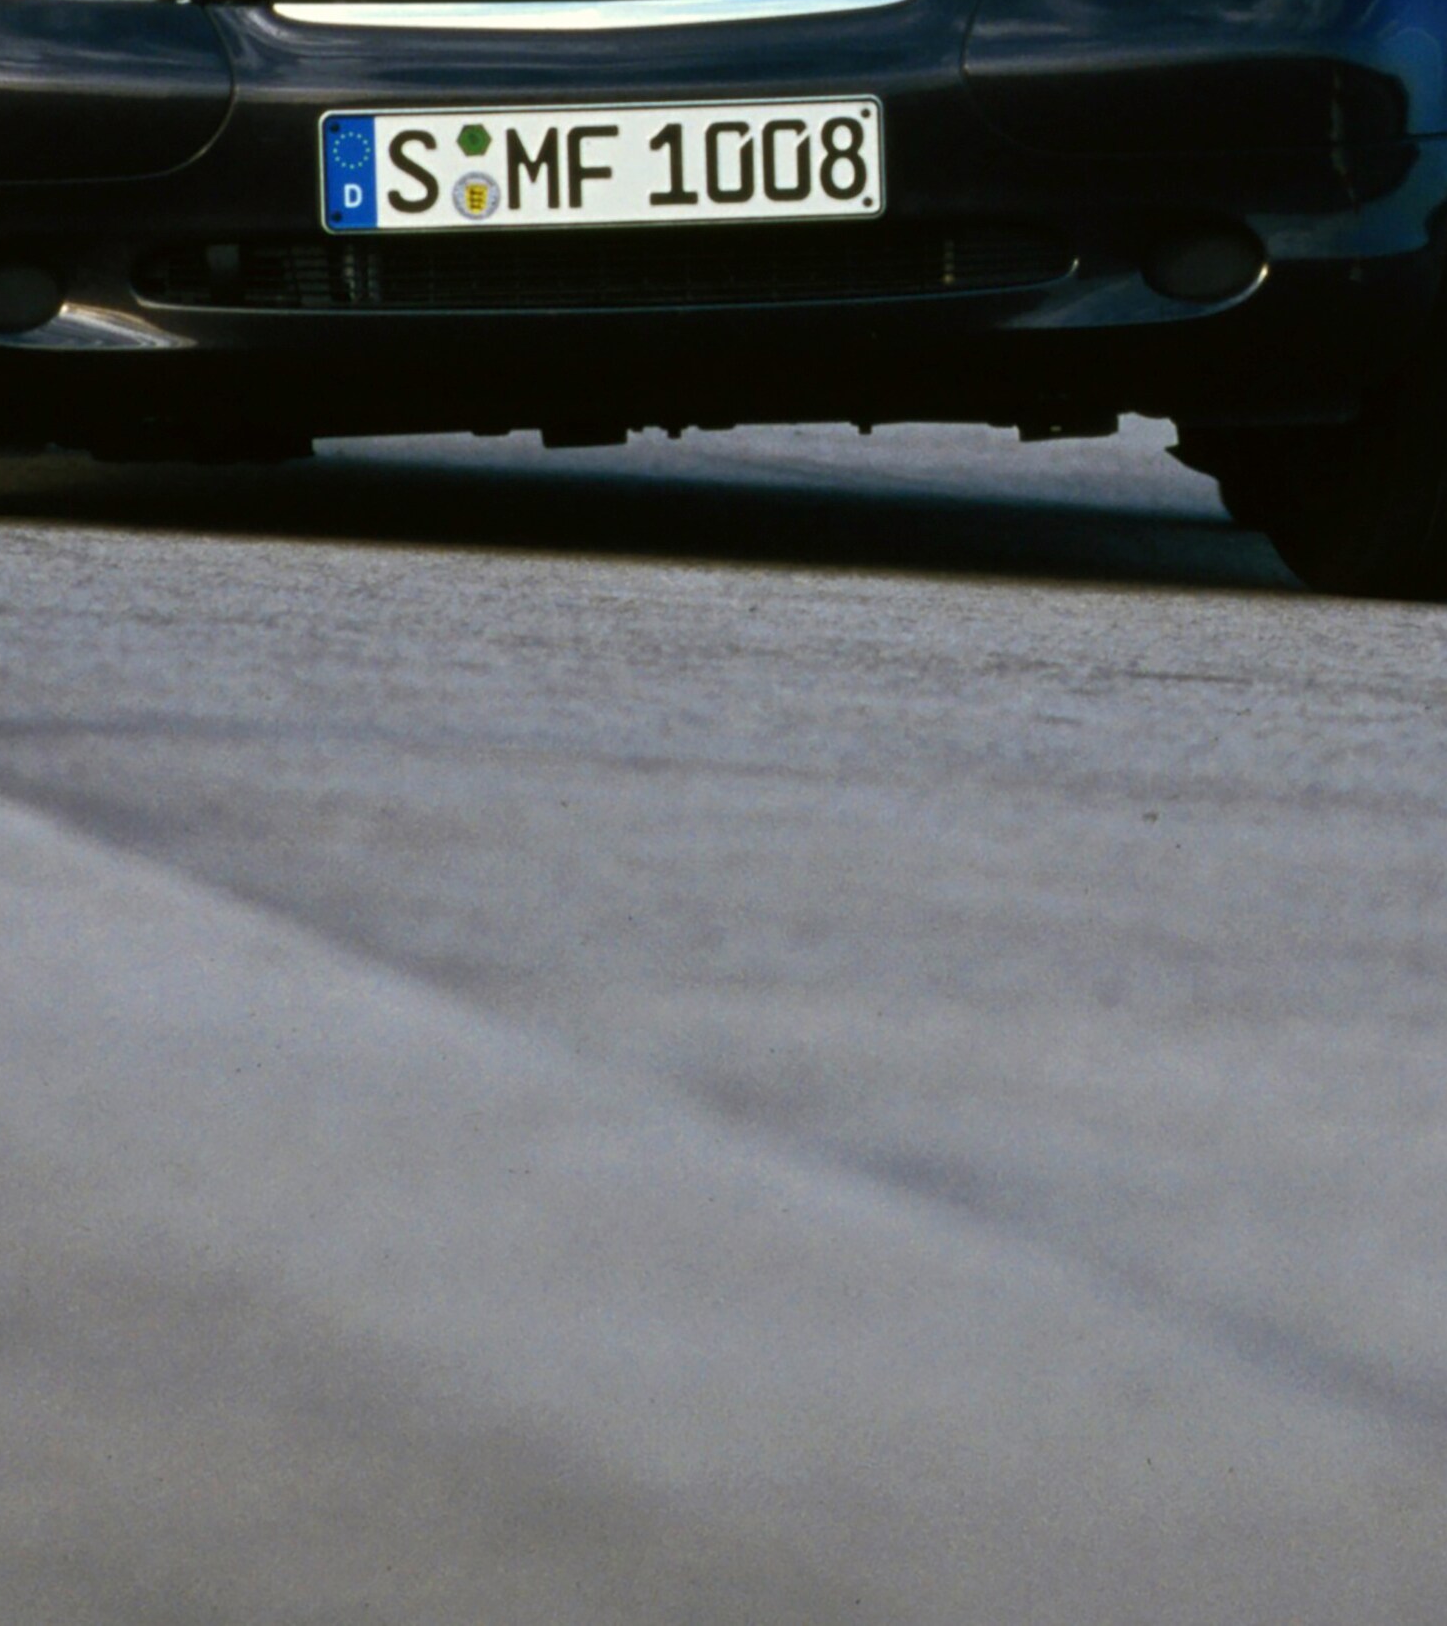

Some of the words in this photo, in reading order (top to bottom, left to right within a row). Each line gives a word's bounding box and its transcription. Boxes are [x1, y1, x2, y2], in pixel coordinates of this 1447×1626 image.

[387, 129, 441, 214] S
[505, 124, 619, 210] MF
[649, 116, 866, 204] 1008
[344, 184, 362, 208] D
